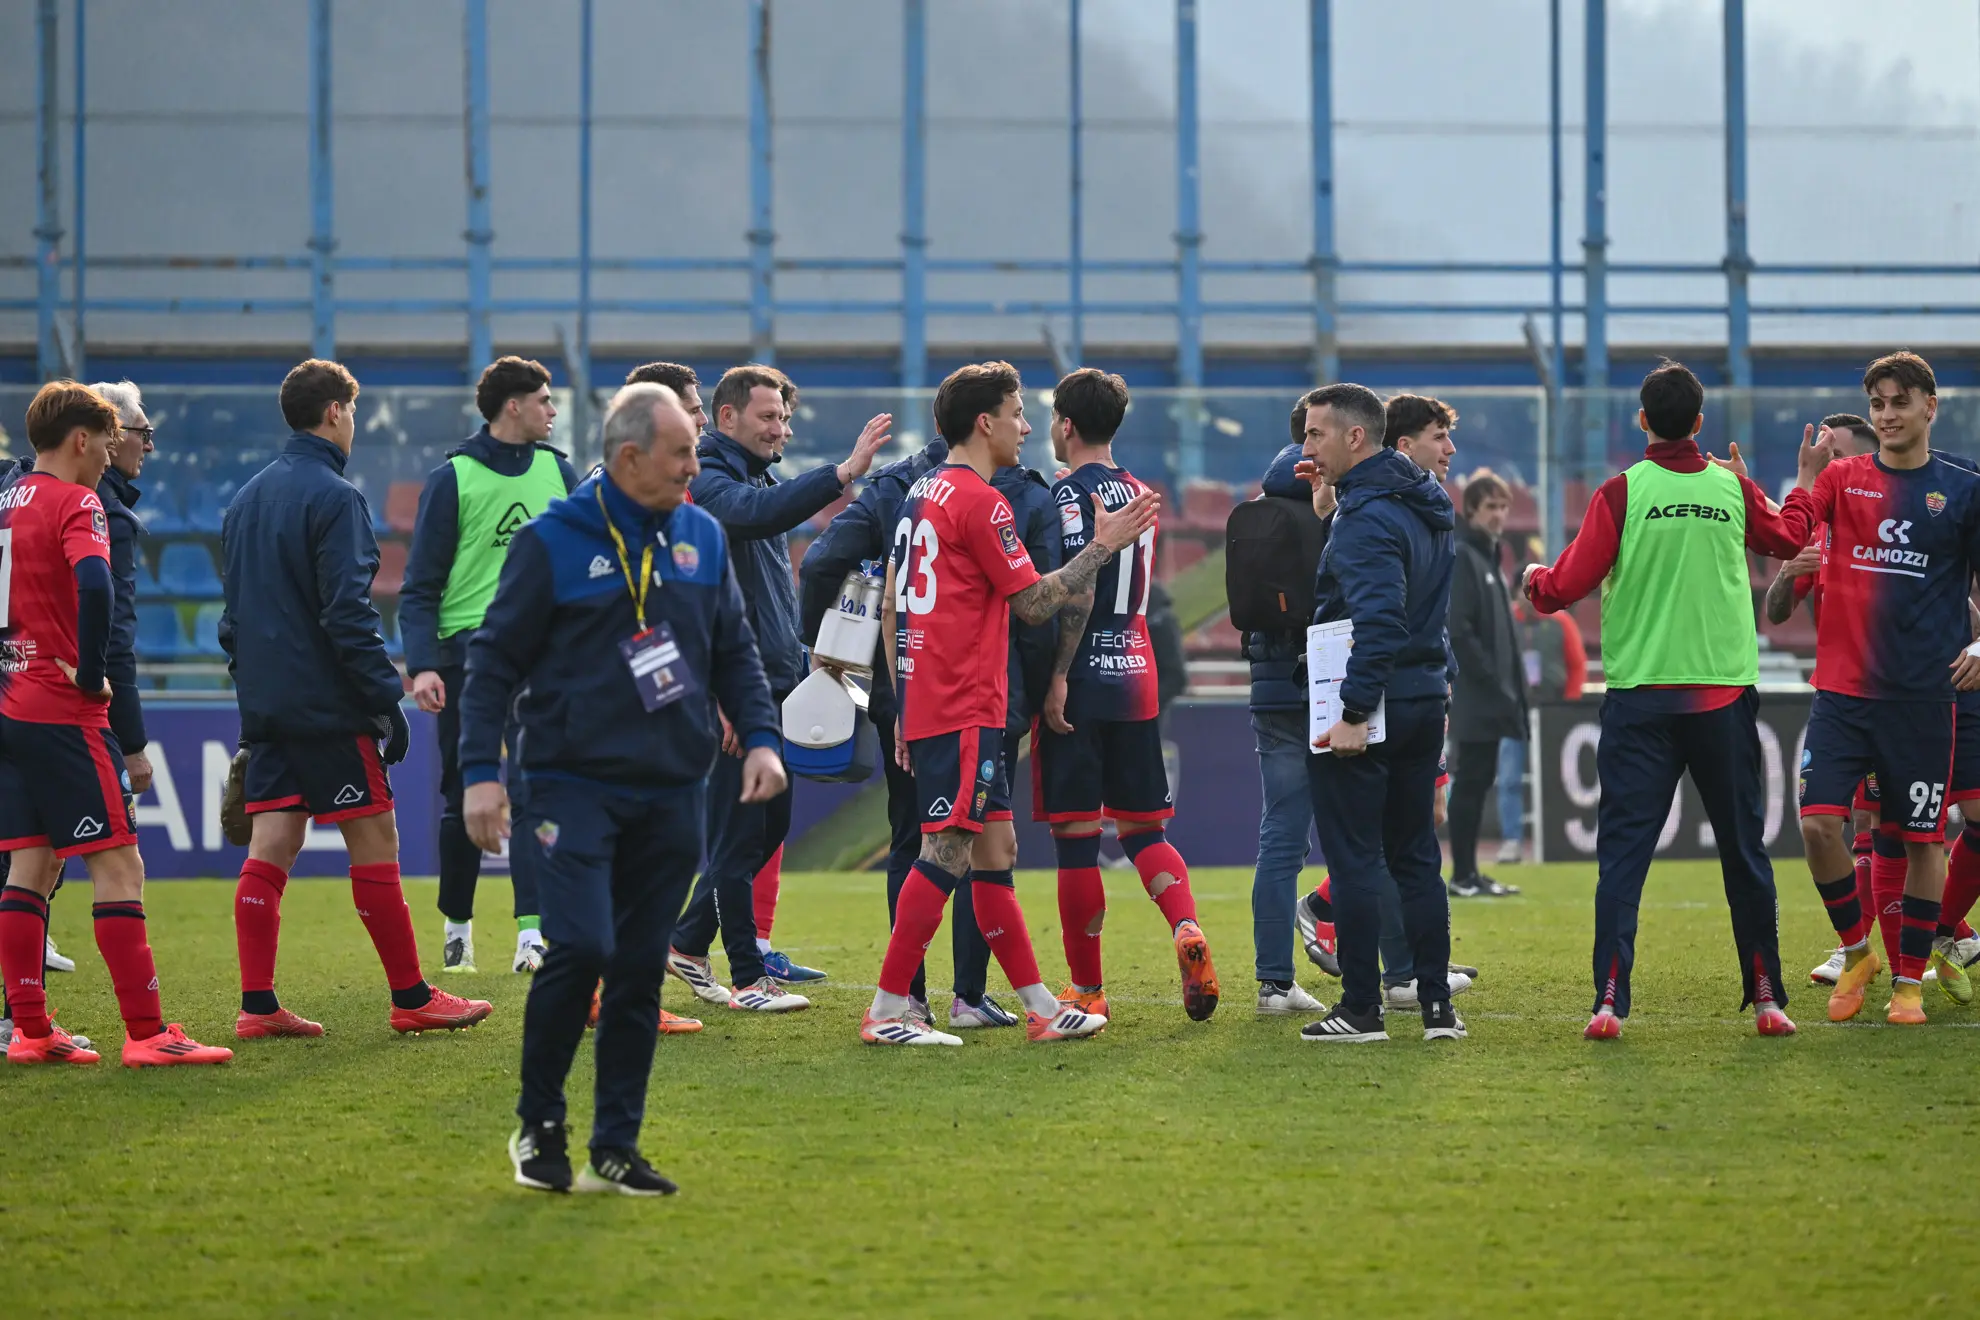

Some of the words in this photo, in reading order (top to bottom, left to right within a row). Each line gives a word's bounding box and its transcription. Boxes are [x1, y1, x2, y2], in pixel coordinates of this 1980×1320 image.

[905, 476, 956, 507] MOSCATI
[1845, 486, 1884, 499] ACERBIS
[1645, 503, 1731, 523] ACERBIS
[1063, 535, 1085, 549] 946
[895, 516, 940, 615] 23
[1852, 544, 1930, 568] CAMOZZI
[1100, 653, 1147, 670] INTRED
[1909, 780, 1945, 820] 95
